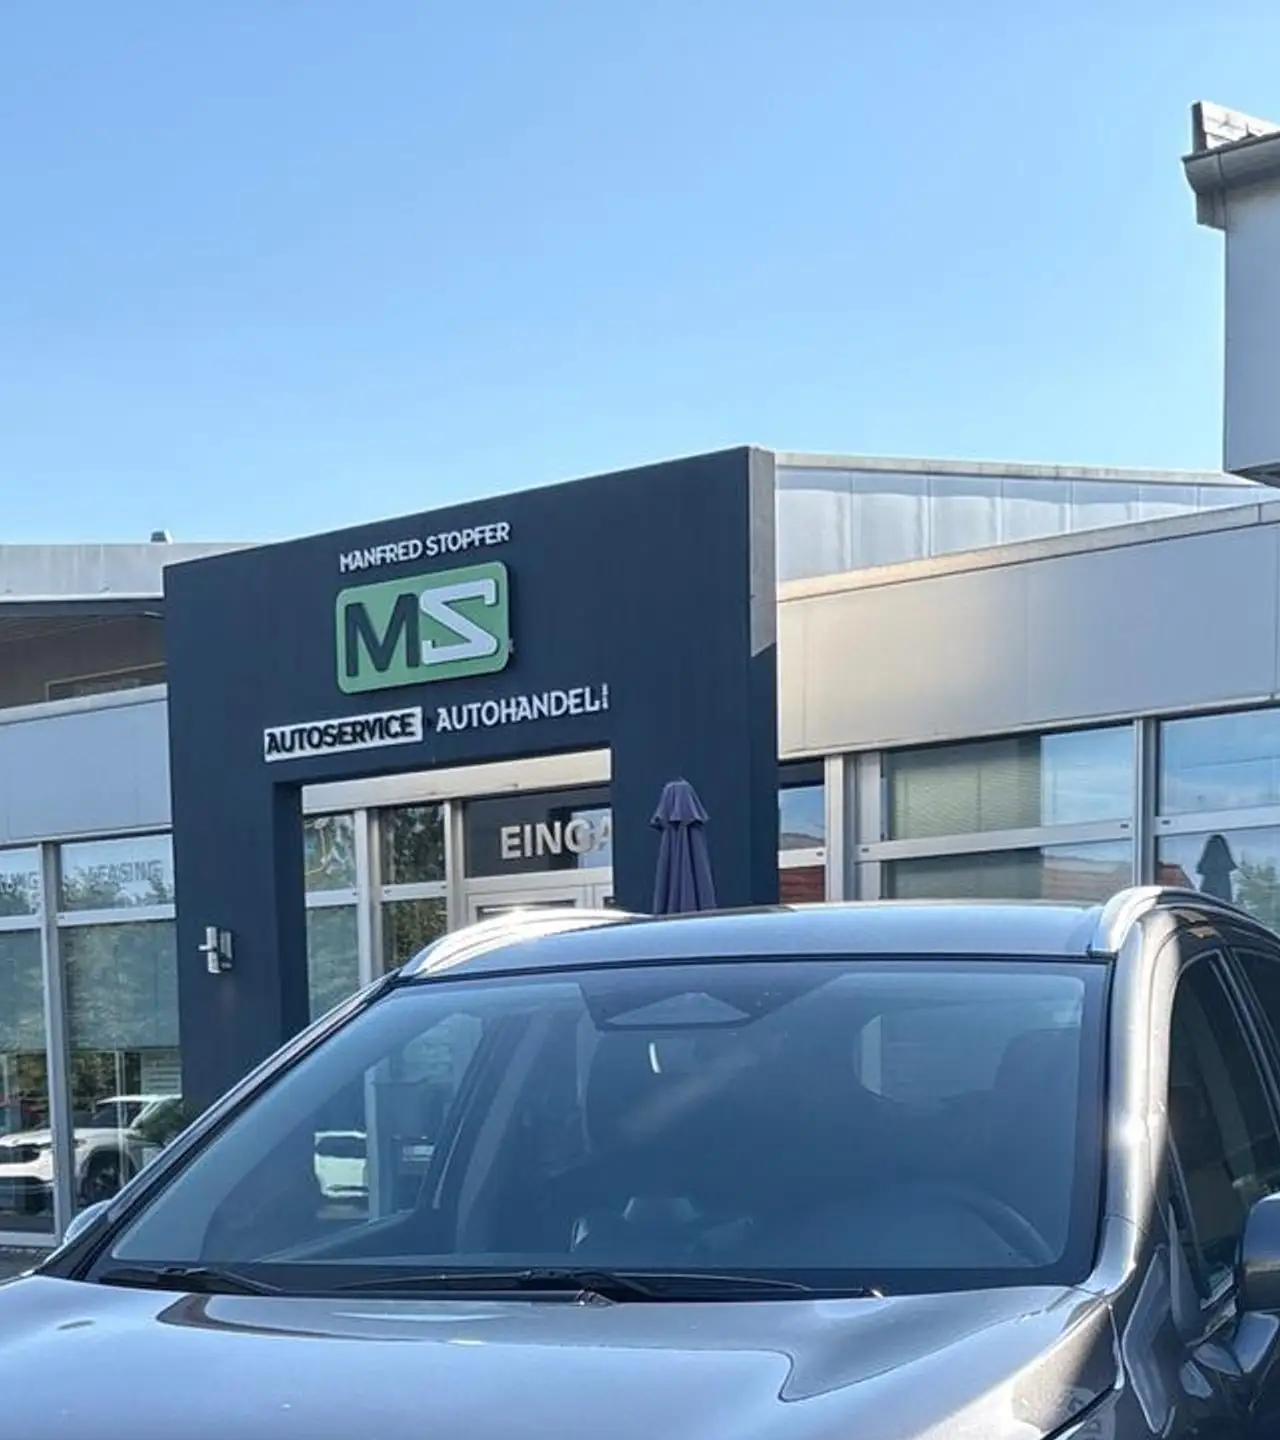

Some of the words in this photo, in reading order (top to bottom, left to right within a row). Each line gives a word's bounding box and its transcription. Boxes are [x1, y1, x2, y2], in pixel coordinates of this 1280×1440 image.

[338, 538, 423, 574] MANFRED
[425, 521, 511, 557] STOPFER
[265, 712, 417, 755] AUTOSERVICE
[436, 685, 601, 733] AUTOHANDEL
